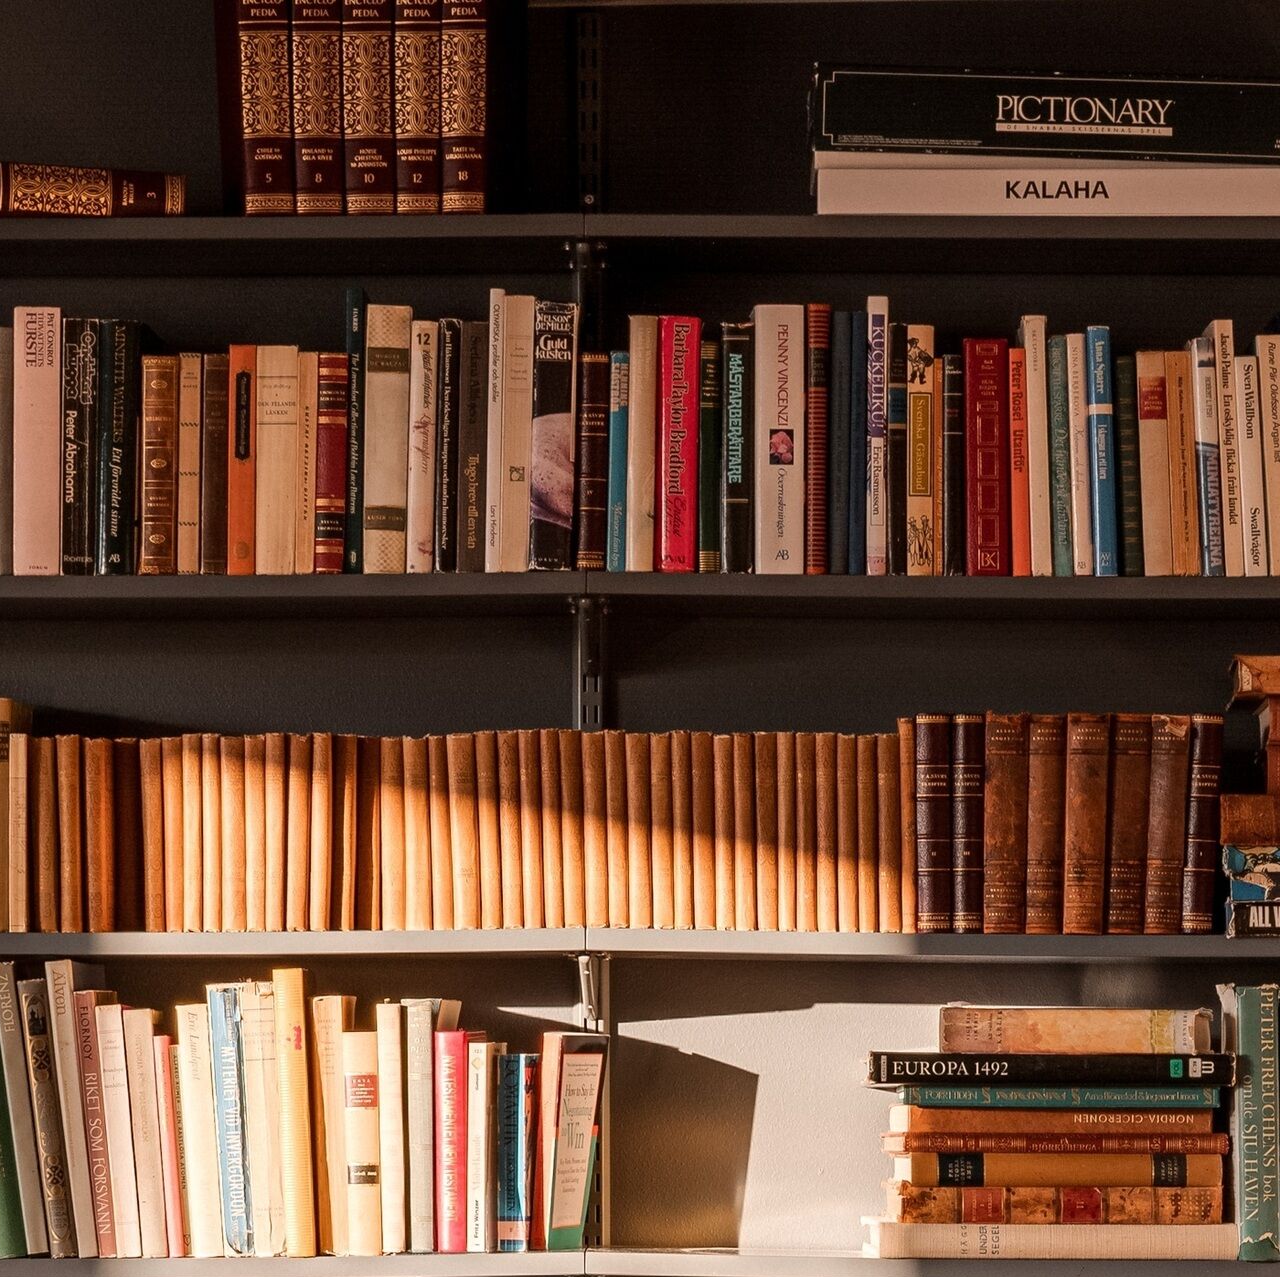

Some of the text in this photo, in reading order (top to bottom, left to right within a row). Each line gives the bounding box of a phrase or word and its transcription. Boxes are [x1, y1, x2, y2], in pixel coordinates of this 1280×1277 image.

[250, 8, 278, 17] PEDIA
[303, 9, 329, 17] PEDIA
[353, 9, 379, 17] PEDIA
[404, 9, 429, 17] PEDIA
[451, 8, 477, 16] PEDIA
[996, 95, 1172, 125] PICTIONARY
[1005, 180, 1109, 199] KALAHA
[25, 313, 37, 367] FURSTE
[47, 330, 55, 366] CONROY
[1268, 342, 1277, 370] Rune
[777, 324, 788, 426] PENNY VINCENZI
[871, 325, 884, 428] KUCKELIKU!
[1011, 361, 1023, 389] Peter
[1244, 364, 1253, 388] Sven
[1269, 370, 1277, 382] Pär
[666, 324, 690, 495] Barbara Taylor Bradford
[728, 354, 743, 483] MÄSTARBERÄTTARE
[1245, 388, 1255, 439] Wallbom
[1270, 384, 1279, 420] Olofsson
[915, 399, 926, 490] Svenska Gästabud
[1220, 333, 1238, 525] Jacob Palme En oskyldig flicka från landet
[1271, 422, 1280, 447] Argan
[65, 410, 77, 503] Peter Abrahams
[1013, 429, 1024, 473] Utanför
[872, 446, 881, 515] Eric Rasmusson
[1250, 905, 1271, 928] ALL
[0, 974, 14, 1032] FLORENZ
[52, 970, 67, 1016] Älven
[892, 1061, 1008, 1076] EUROPA 1492
[1261, 992, 1277, 1202] PETER FREUCHENS bok
[79, 1006, 112, 1234] FLORNOY RIKET SOM FÖRSVANN
[1074, 1114, 1194, 1123] NORDIA-CICERONEN
[1243, 1075, 1259, 1222] om de SJU HAVEN
[979, 1226, 988, 1255] UNDER
[992, 1226, 1000, 1255] SEGEL
